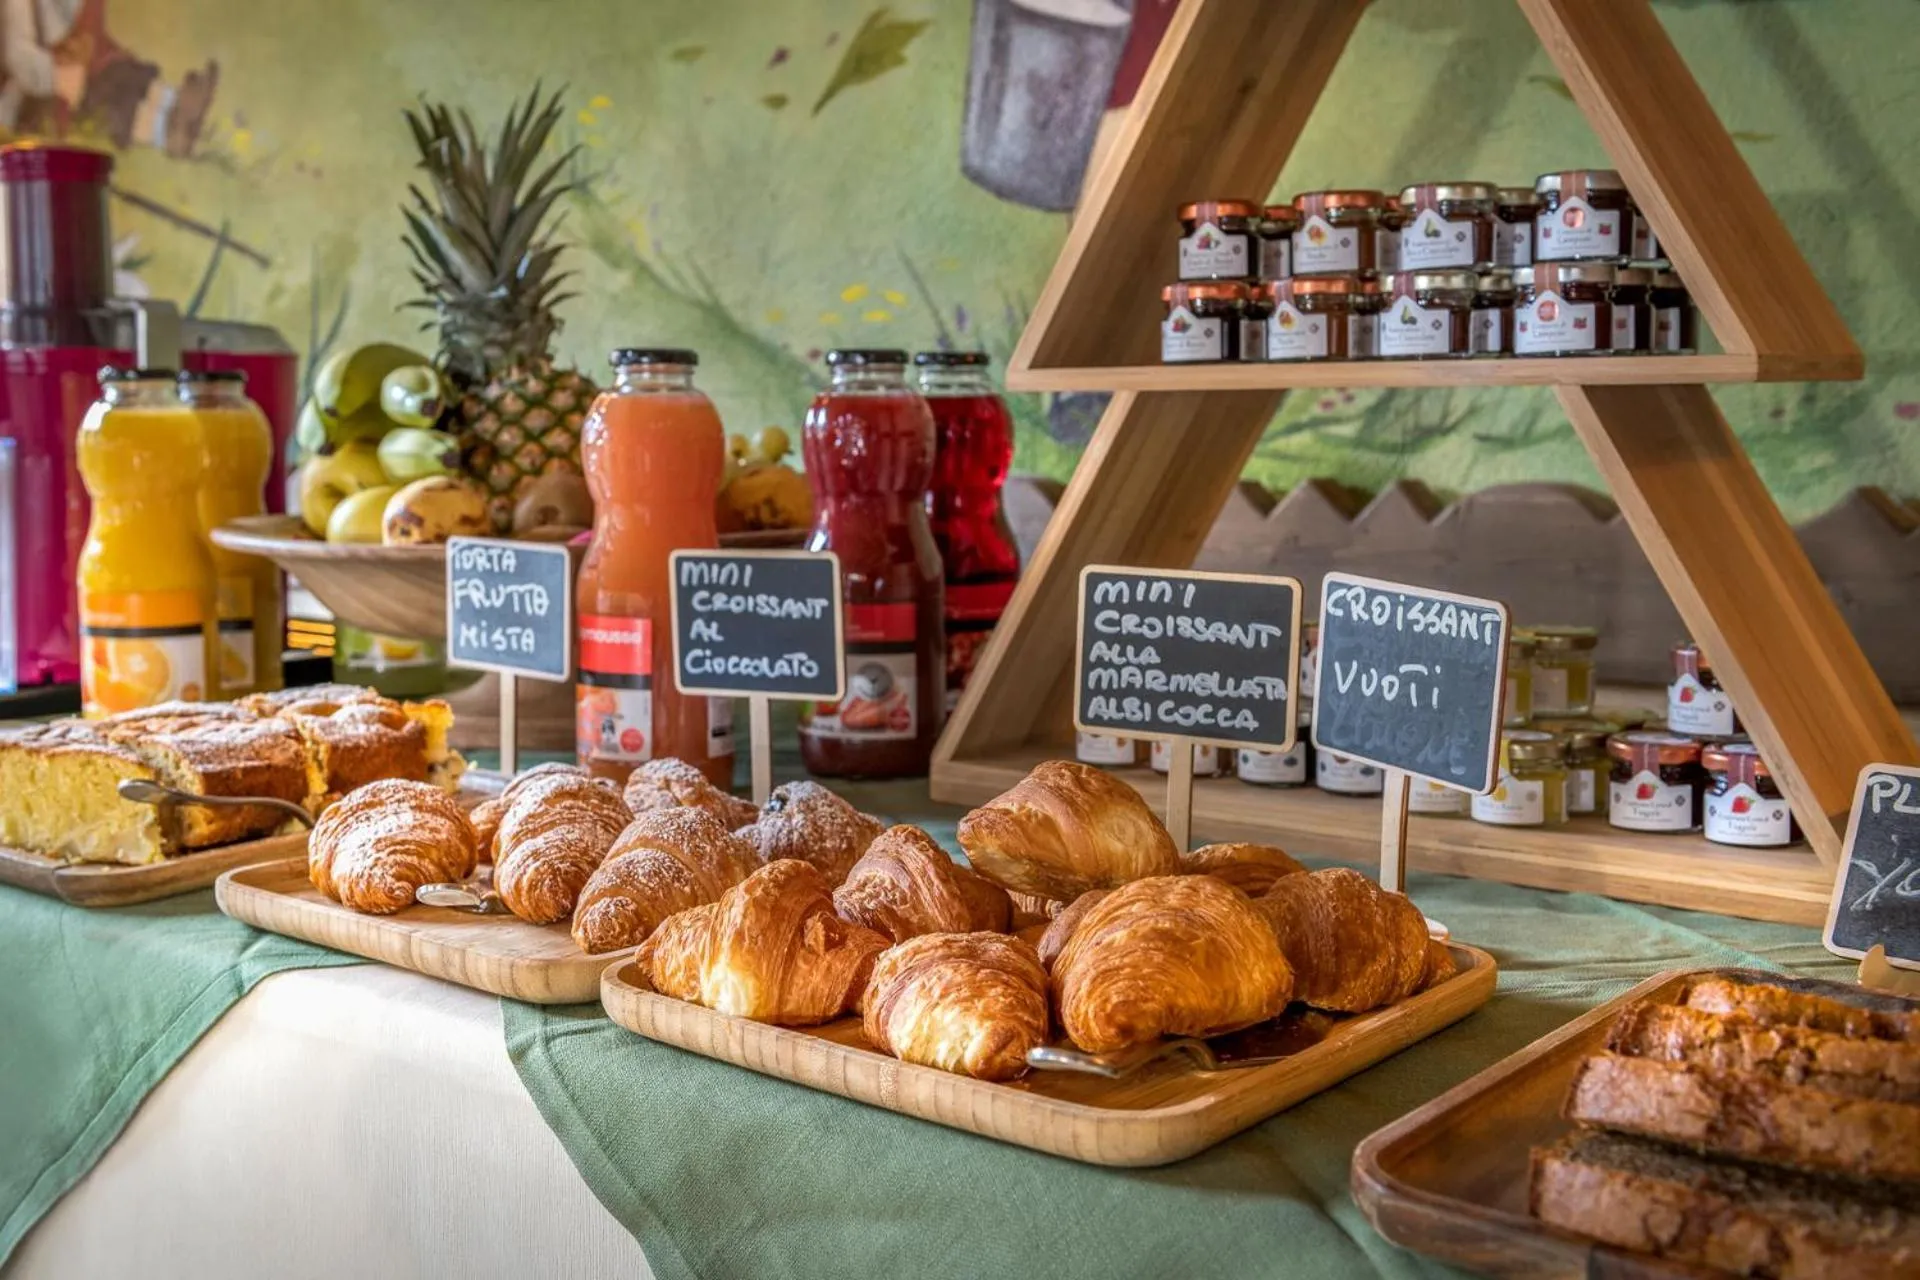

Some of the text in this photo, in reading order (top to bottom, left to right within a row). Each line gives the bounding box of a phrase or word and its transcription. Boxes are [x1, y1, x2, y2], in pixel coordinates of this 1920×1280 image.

[691, 589, 829, 620] CROISSANT
[1326, 586, 1501, 646] CROISSANT
[690, 616, 724, 643] AL
[1094, 609, 1281, 649] CROISSANT
[1088, 640, 1161, 665] ALLA
